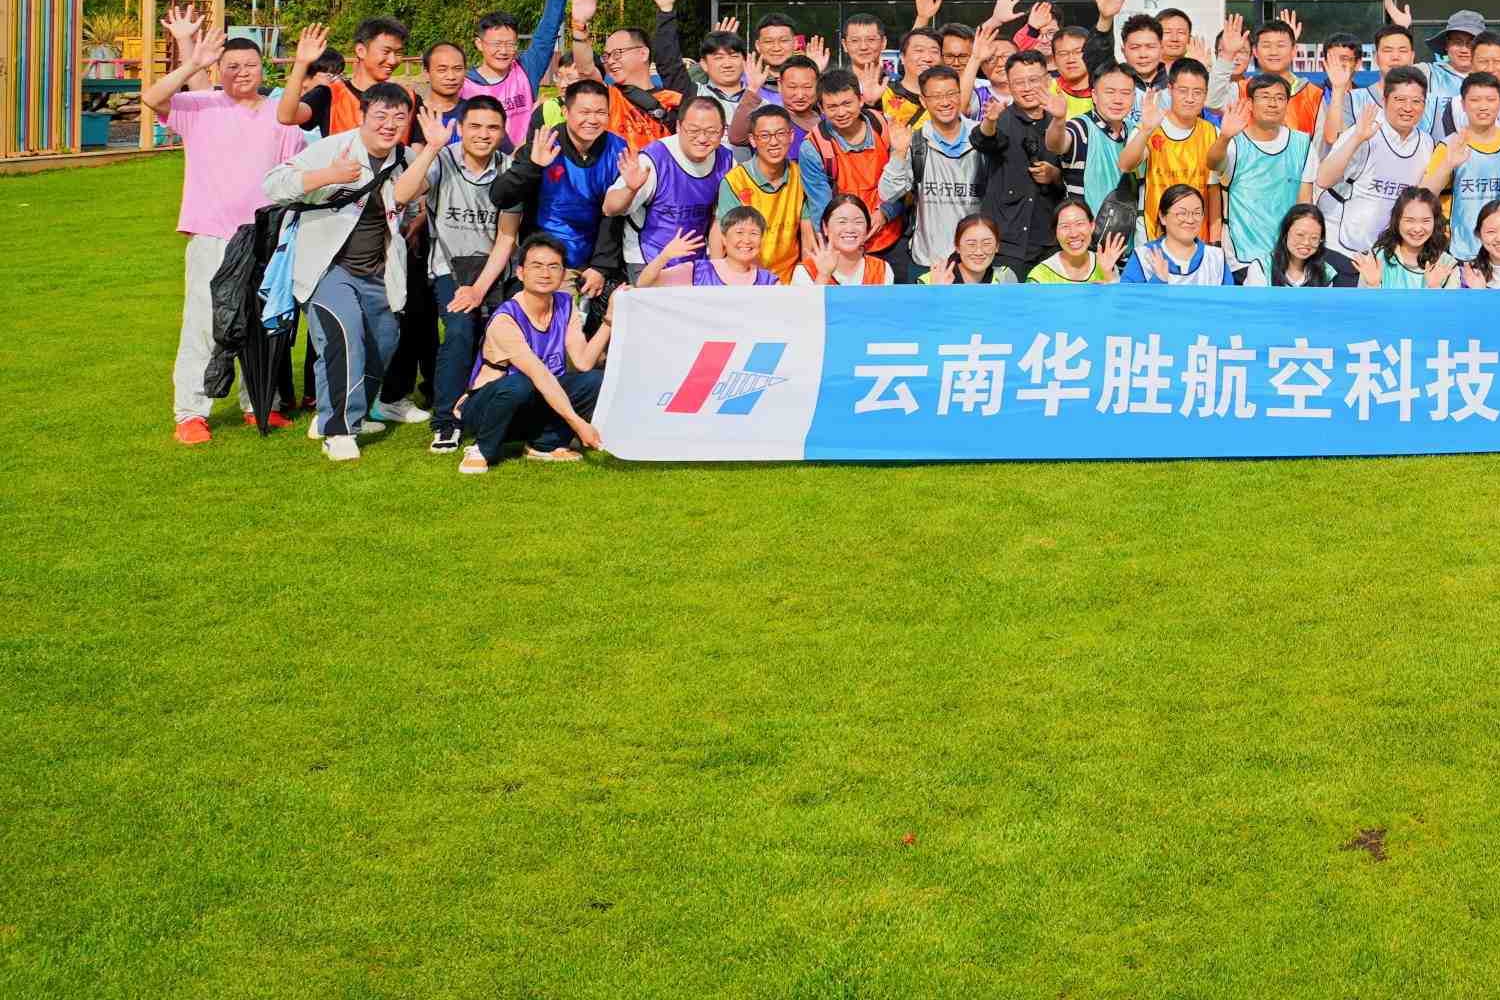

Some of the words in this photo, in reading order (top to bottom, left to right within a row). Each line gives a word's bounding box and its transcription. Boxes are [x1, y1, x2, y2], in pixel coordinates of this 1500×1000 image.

[1369, 178, 1408, 196] 天行团
[853, 331, 1500, 421] 云南华胜航空科技
